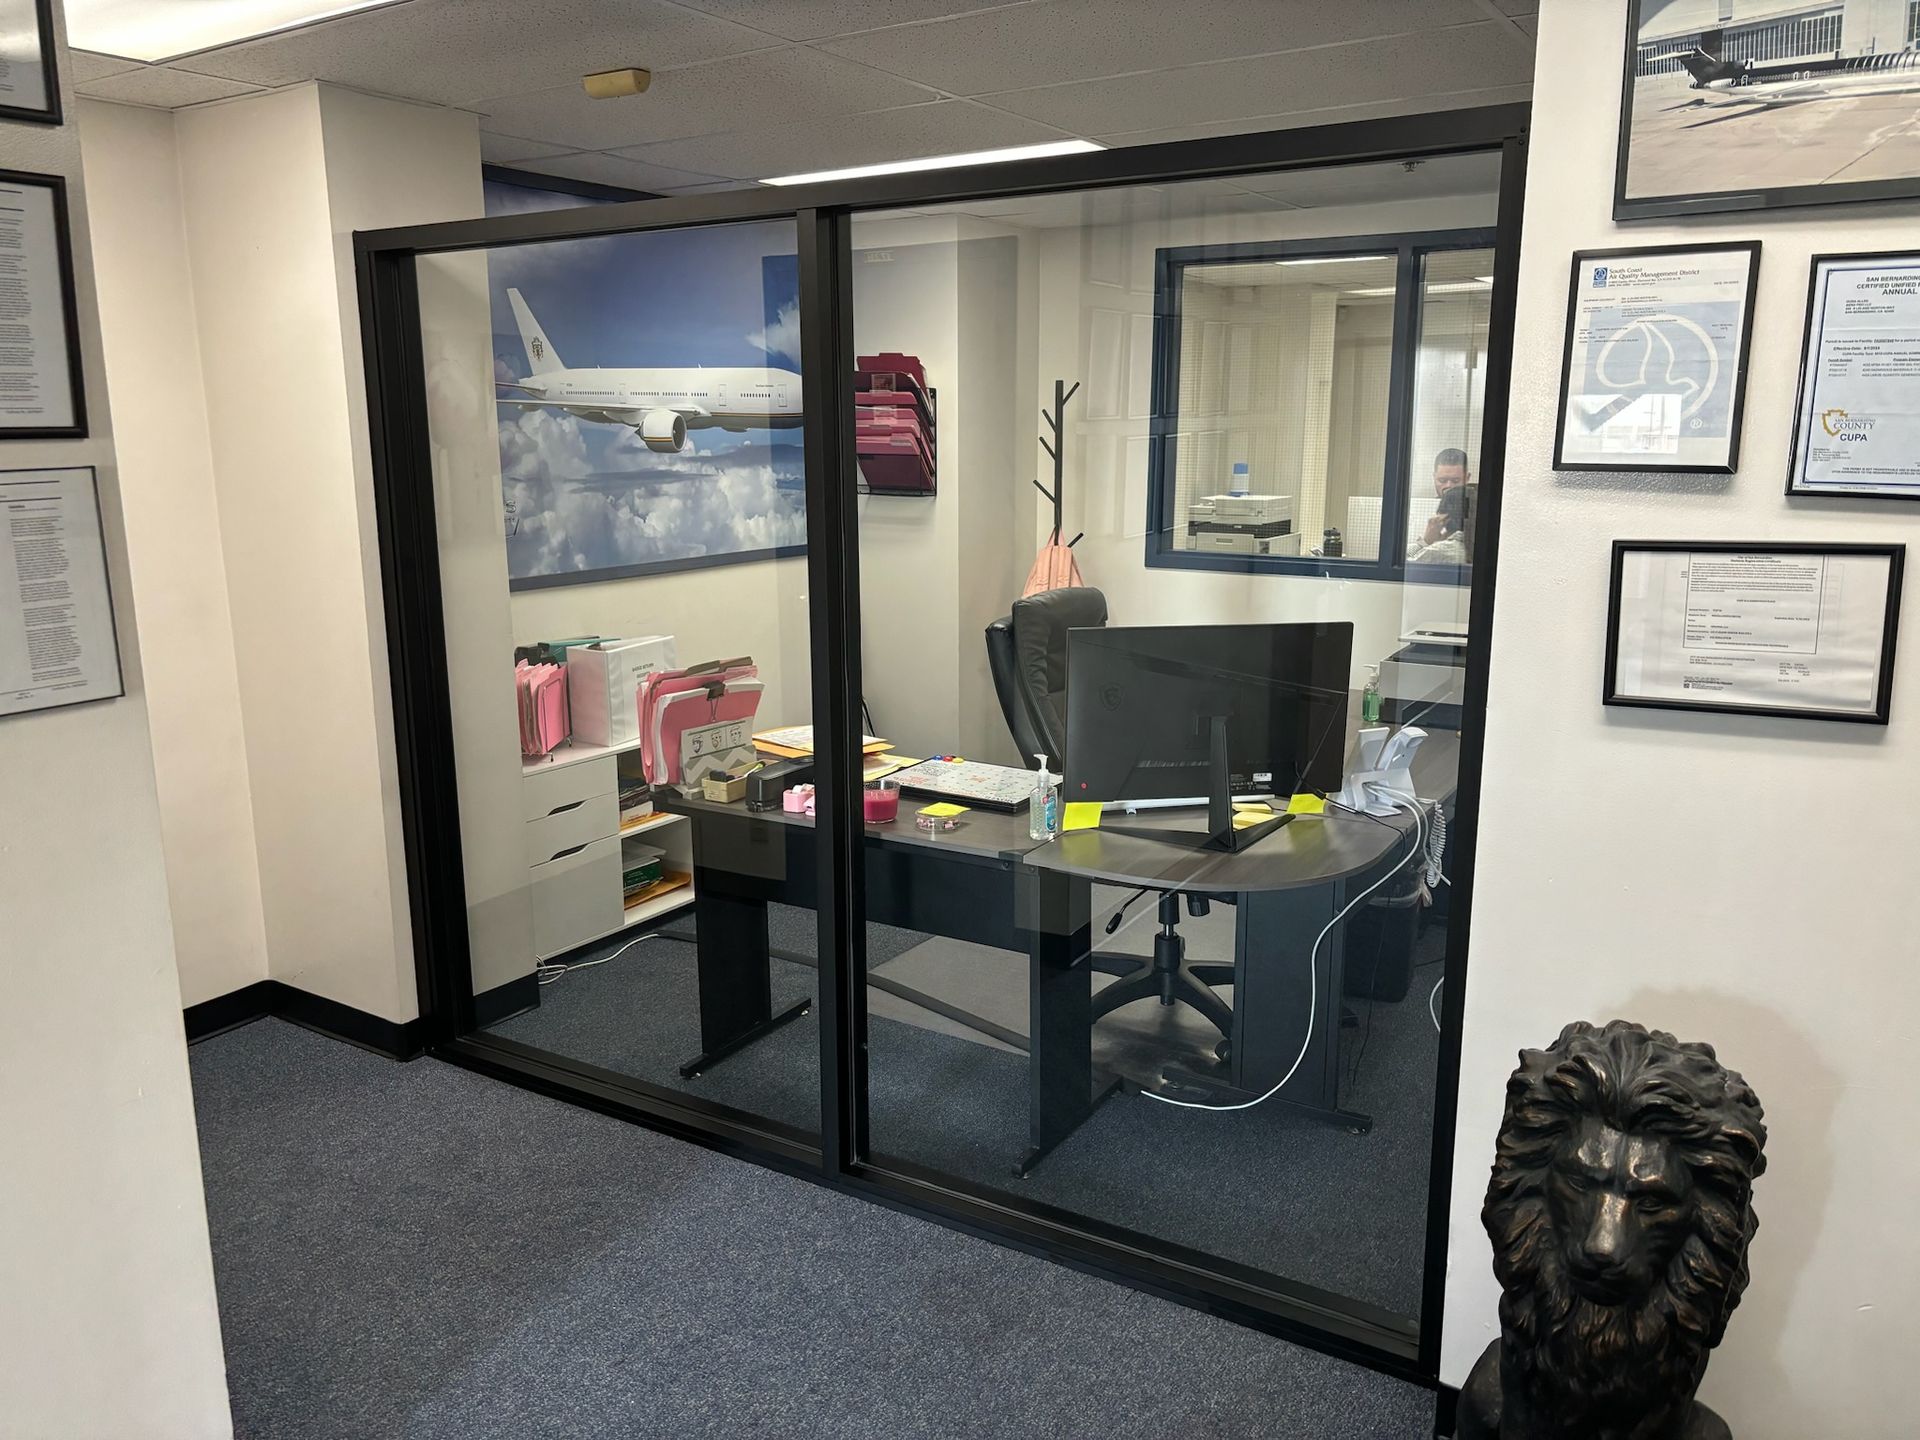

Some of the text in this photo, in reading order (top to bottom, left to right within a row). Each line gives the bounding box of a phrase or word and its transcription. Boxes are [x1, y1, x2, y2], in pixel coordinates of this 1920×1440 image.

[1640, 271, 1678, 279] Management
[1881, 288, 1918, 296] ANNUAL
[1833, 422, 1875, 430] COUNTY
[1840, 433, 1868, 441] CUPA
